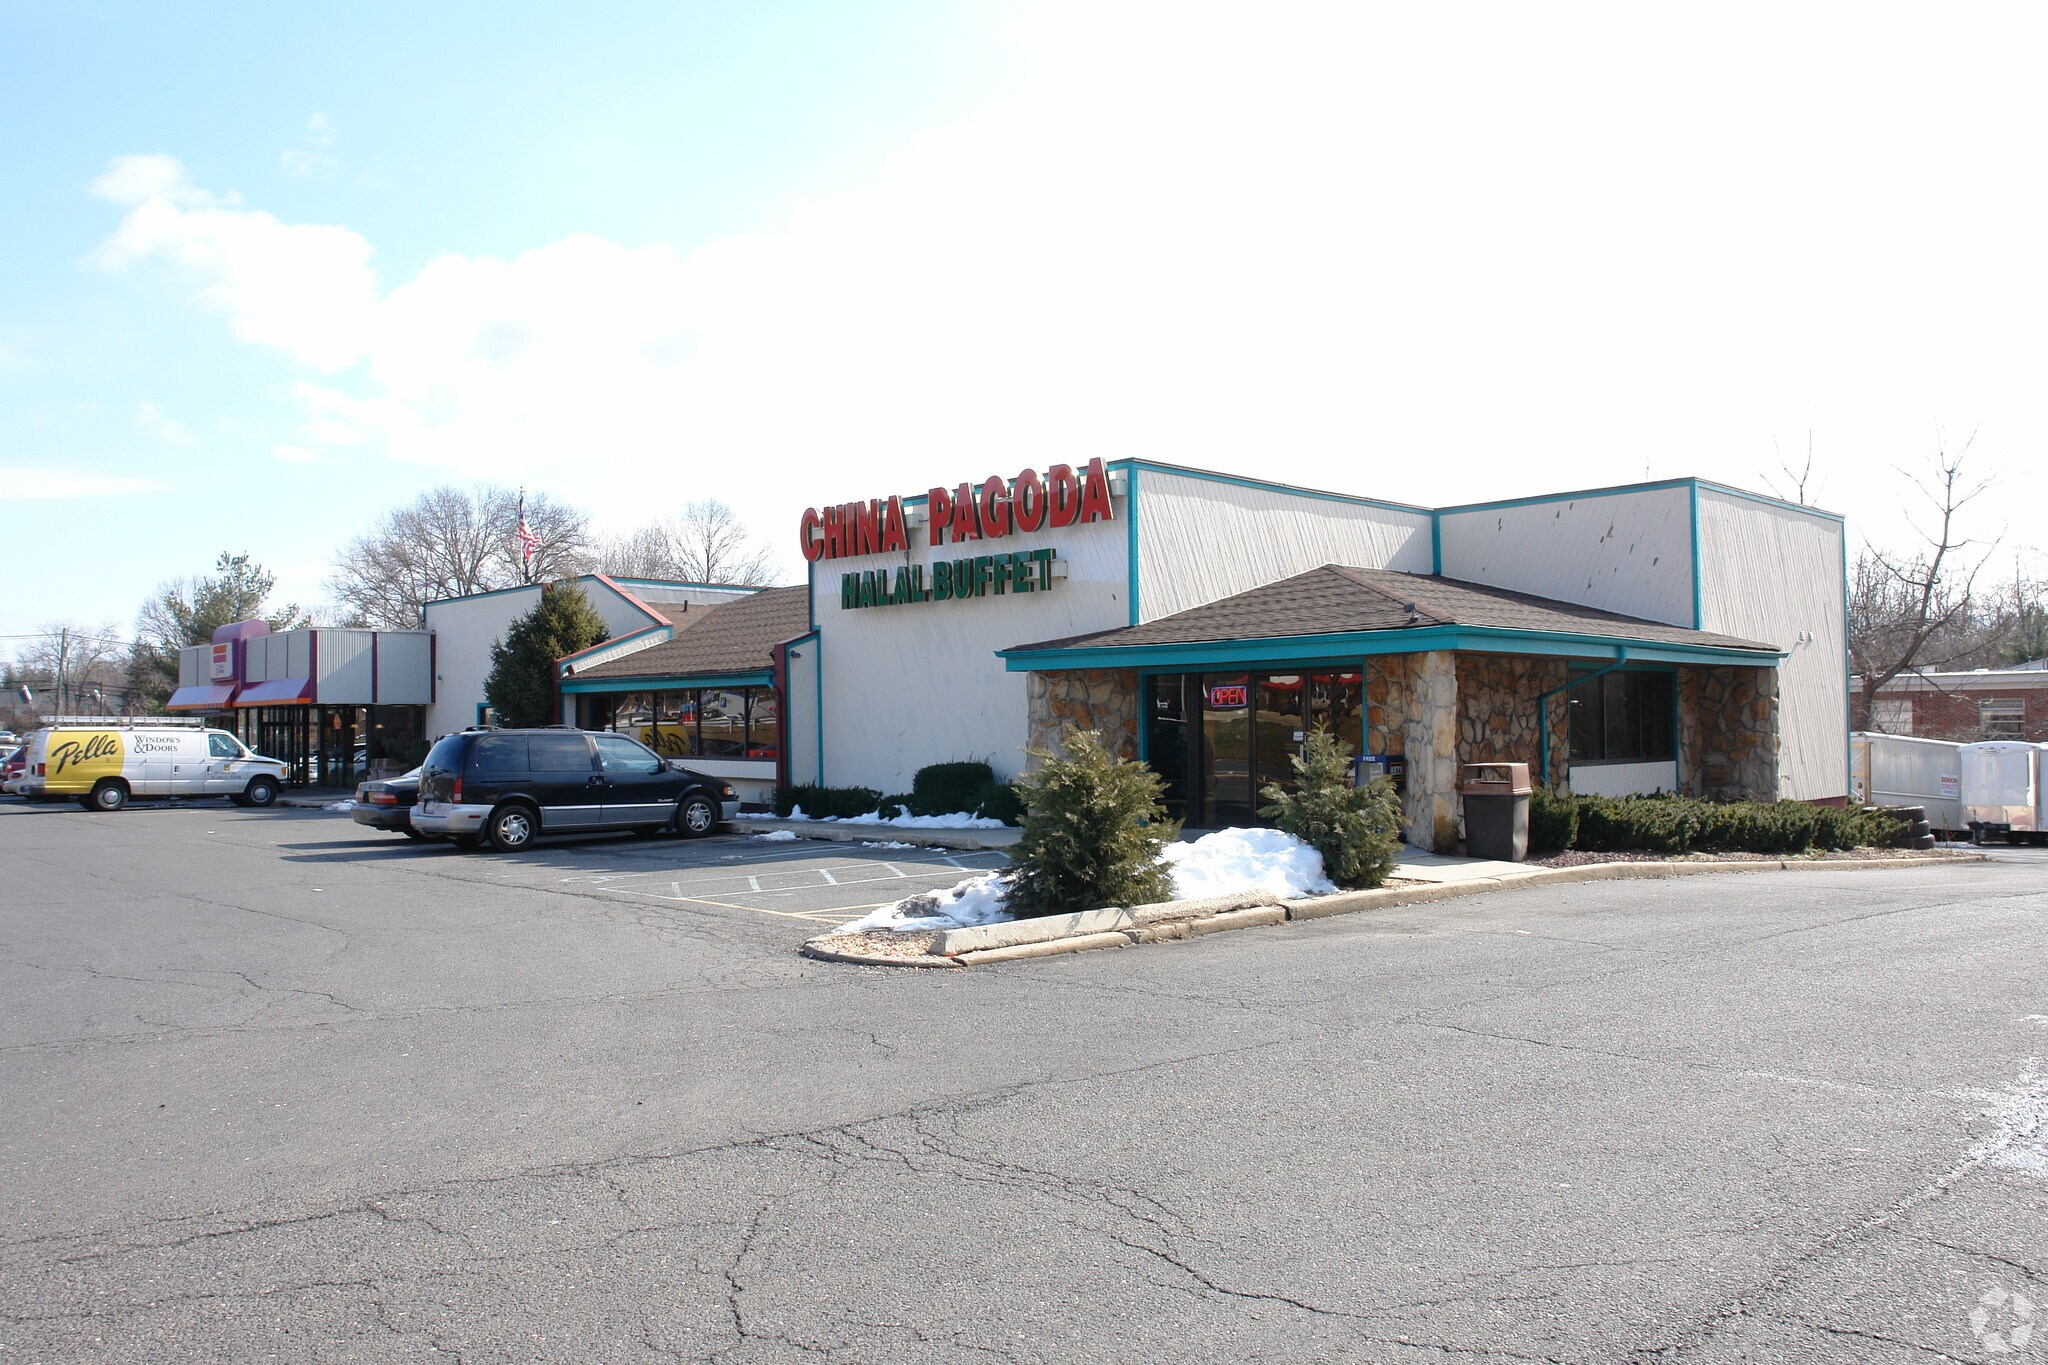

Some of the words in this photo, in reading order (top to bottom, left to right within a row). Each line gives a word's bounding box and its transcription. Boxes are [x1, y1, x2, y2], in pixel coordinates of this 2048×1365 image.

[800, 495, 910, 562] CHINA
[928, 457, 1115, 546] PAGODA
[841, 564, 930, 610] HALAL
[932, 548, 1056, 601] BUFFET
[1213, 688, 1246, 705] OPEN
[51, 734, 118, 774] Pella
